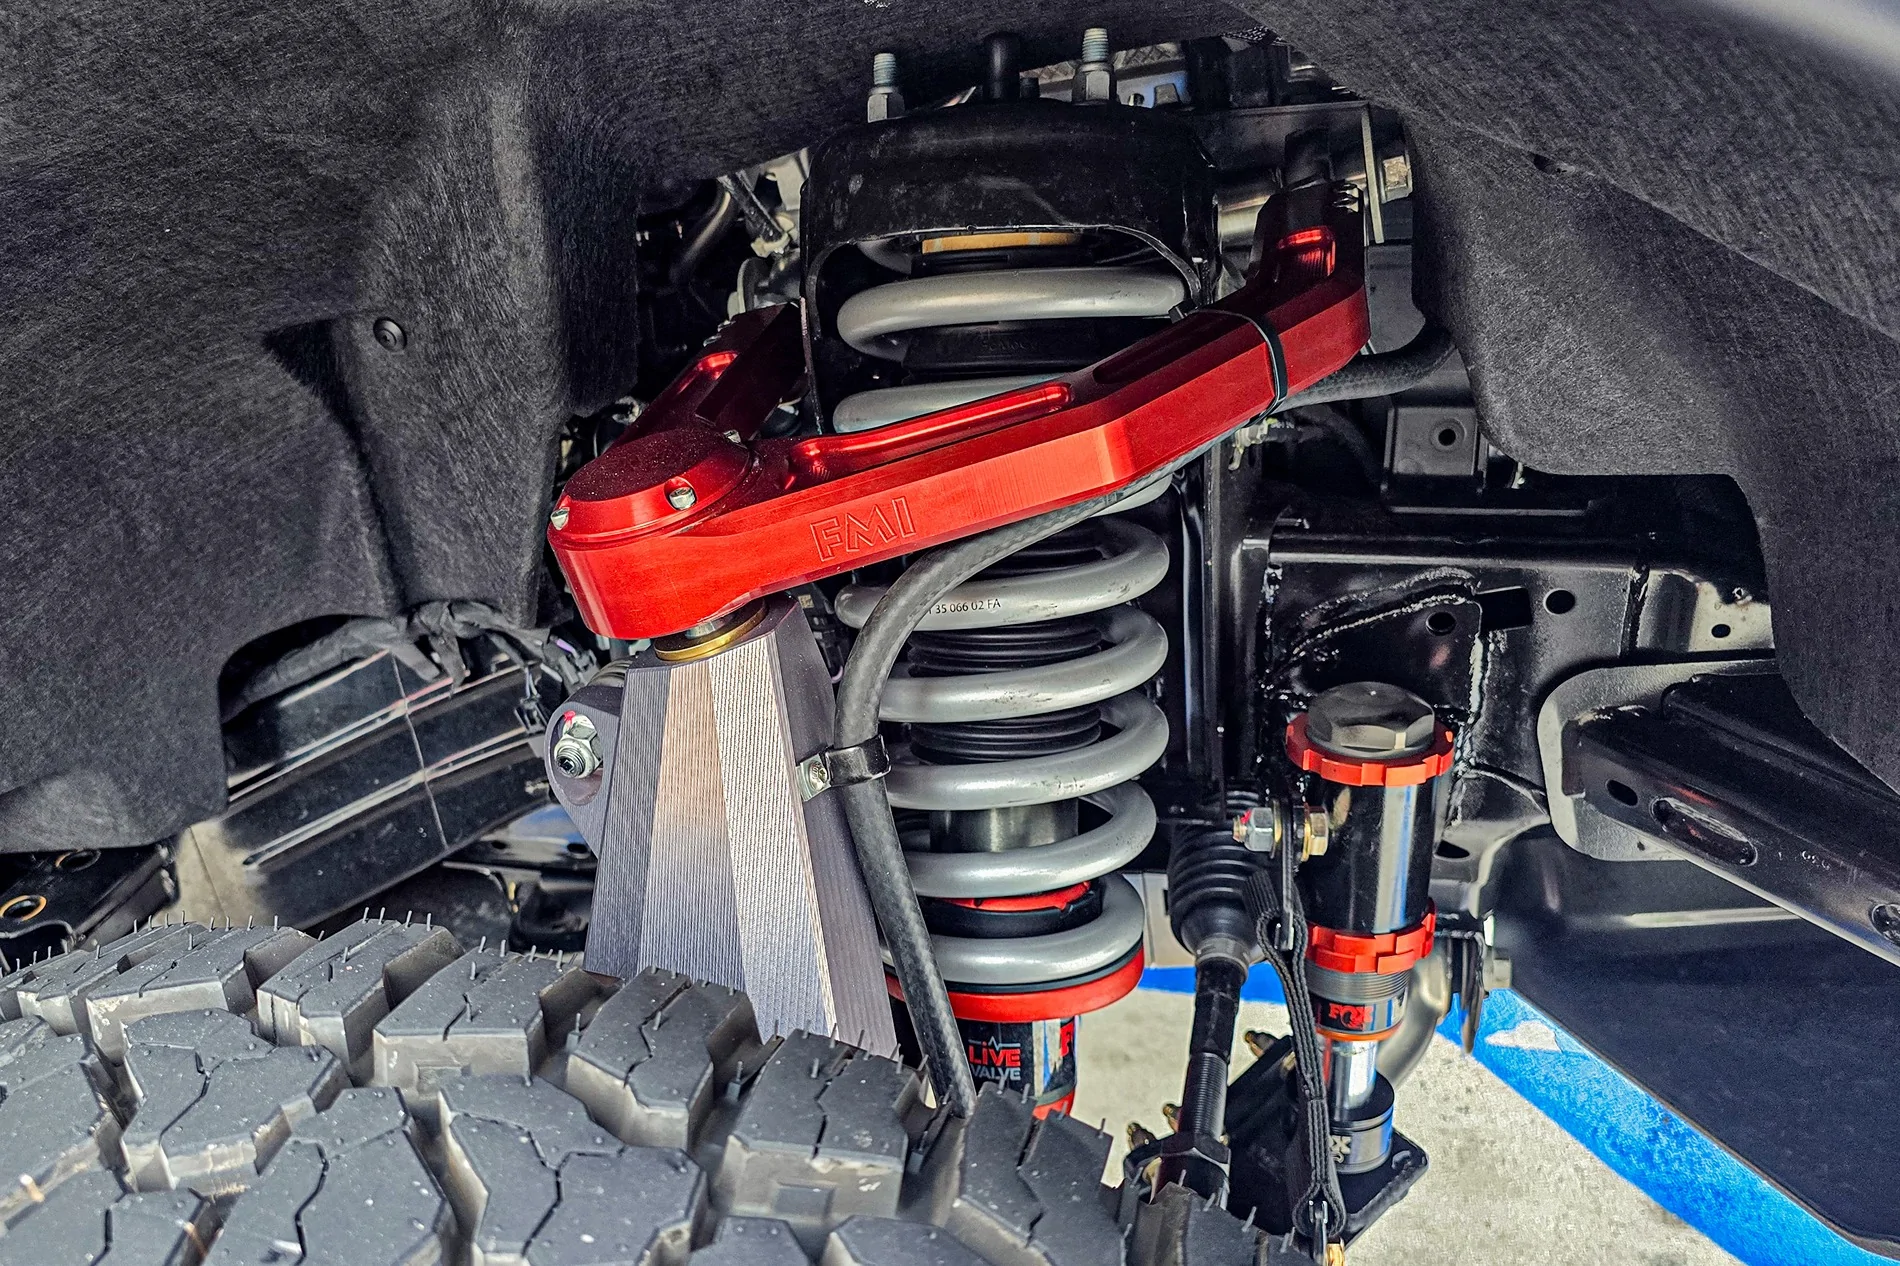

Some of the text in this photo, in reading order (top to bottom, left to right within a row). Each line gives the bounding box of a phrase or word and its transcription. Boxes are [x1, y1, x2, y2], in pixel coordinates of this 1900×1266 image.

[810, 496, 916, 562] FMI
[935, 604, 947, 614] 35
[949, 602, 969, 613] 066
[971, 600, 985, 611] 02
[987, 598, 1001, 609] FA
[1328, 1003, 1374, 1030] FOX
[970, 1063, 1021, 1081] VALVE
